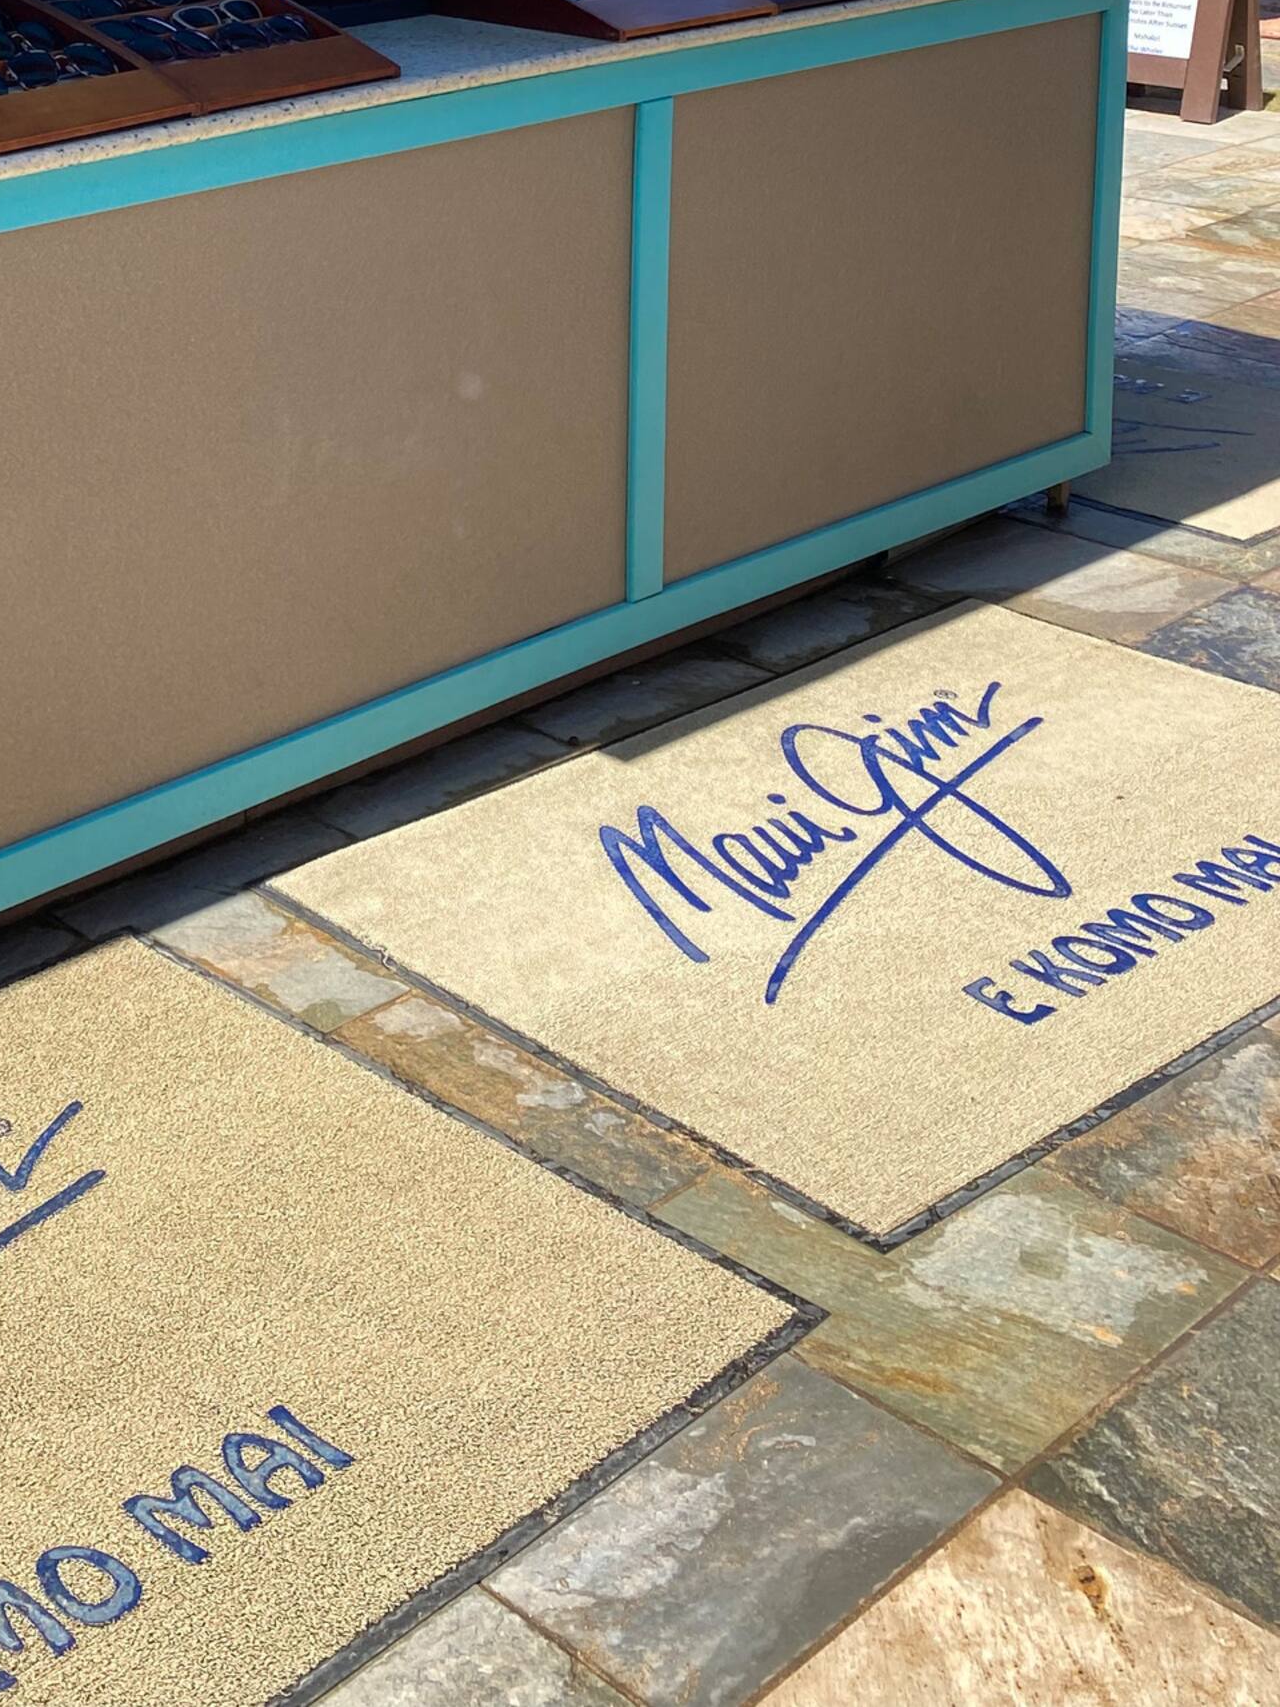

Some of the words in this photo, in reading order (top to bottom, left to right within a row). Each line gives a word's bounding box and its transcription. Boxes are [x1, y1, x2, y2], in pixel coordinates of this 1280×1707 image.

[599, 792, 856, 964] Maui
[780, 681, 1072, 899] Jim
[962, 976, 1058, 1026] E
[1010, 894, 1215, 998] KOMO
[121, 1405, 357, 1567] MAI
